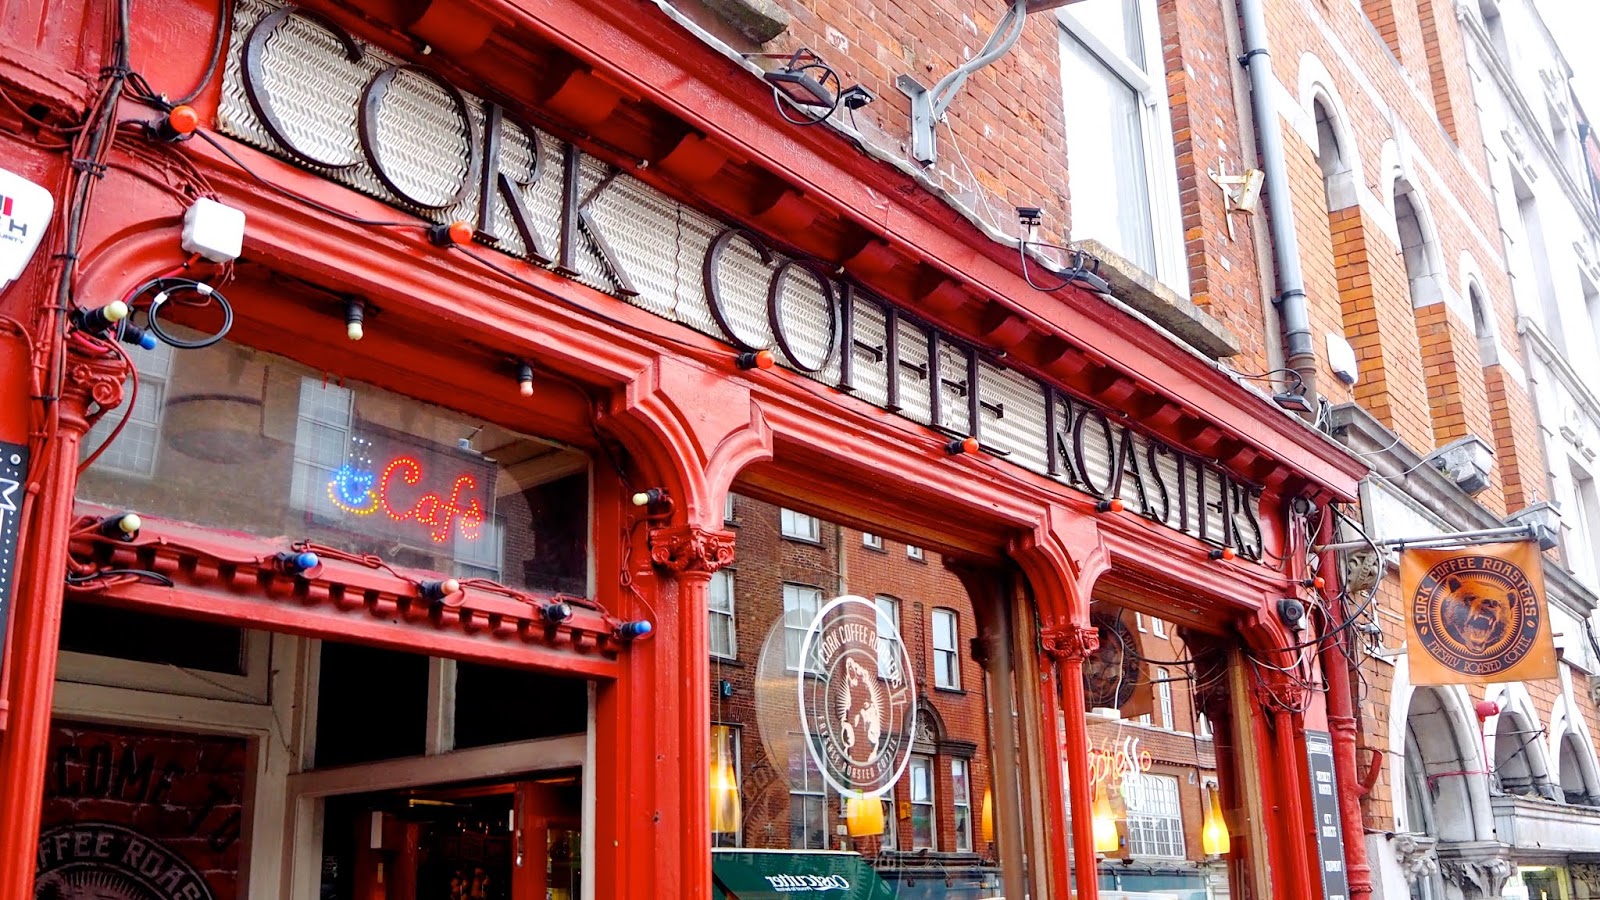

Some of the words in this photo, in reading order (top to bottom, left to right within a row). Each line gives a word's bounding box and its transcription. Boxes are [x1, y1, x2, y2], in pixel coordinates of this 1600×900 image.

[242, 5, 639, 297] CORK
[703, 228, 1011, 457] COFFEE
[1043, 383, 1264, 565] ROASTERS
[1416, 586, 1432, 624] CORK
[1428, 557, 1476, 582] COFFEE
[1482, 557, 1537, 616] ROASTERS
[819, 630, 841, 665] CORK
[838, 623, 869, 645] COFFEE
[1427, 641, 1461, 668] FRESHLY
[1464, 659, 1502, 673] ROASTED
[1504, 634, 1532, 663] COFFEE
[841, 762, 875, 780] ROASTED
[877, 738, 897, 773] COFFEE
